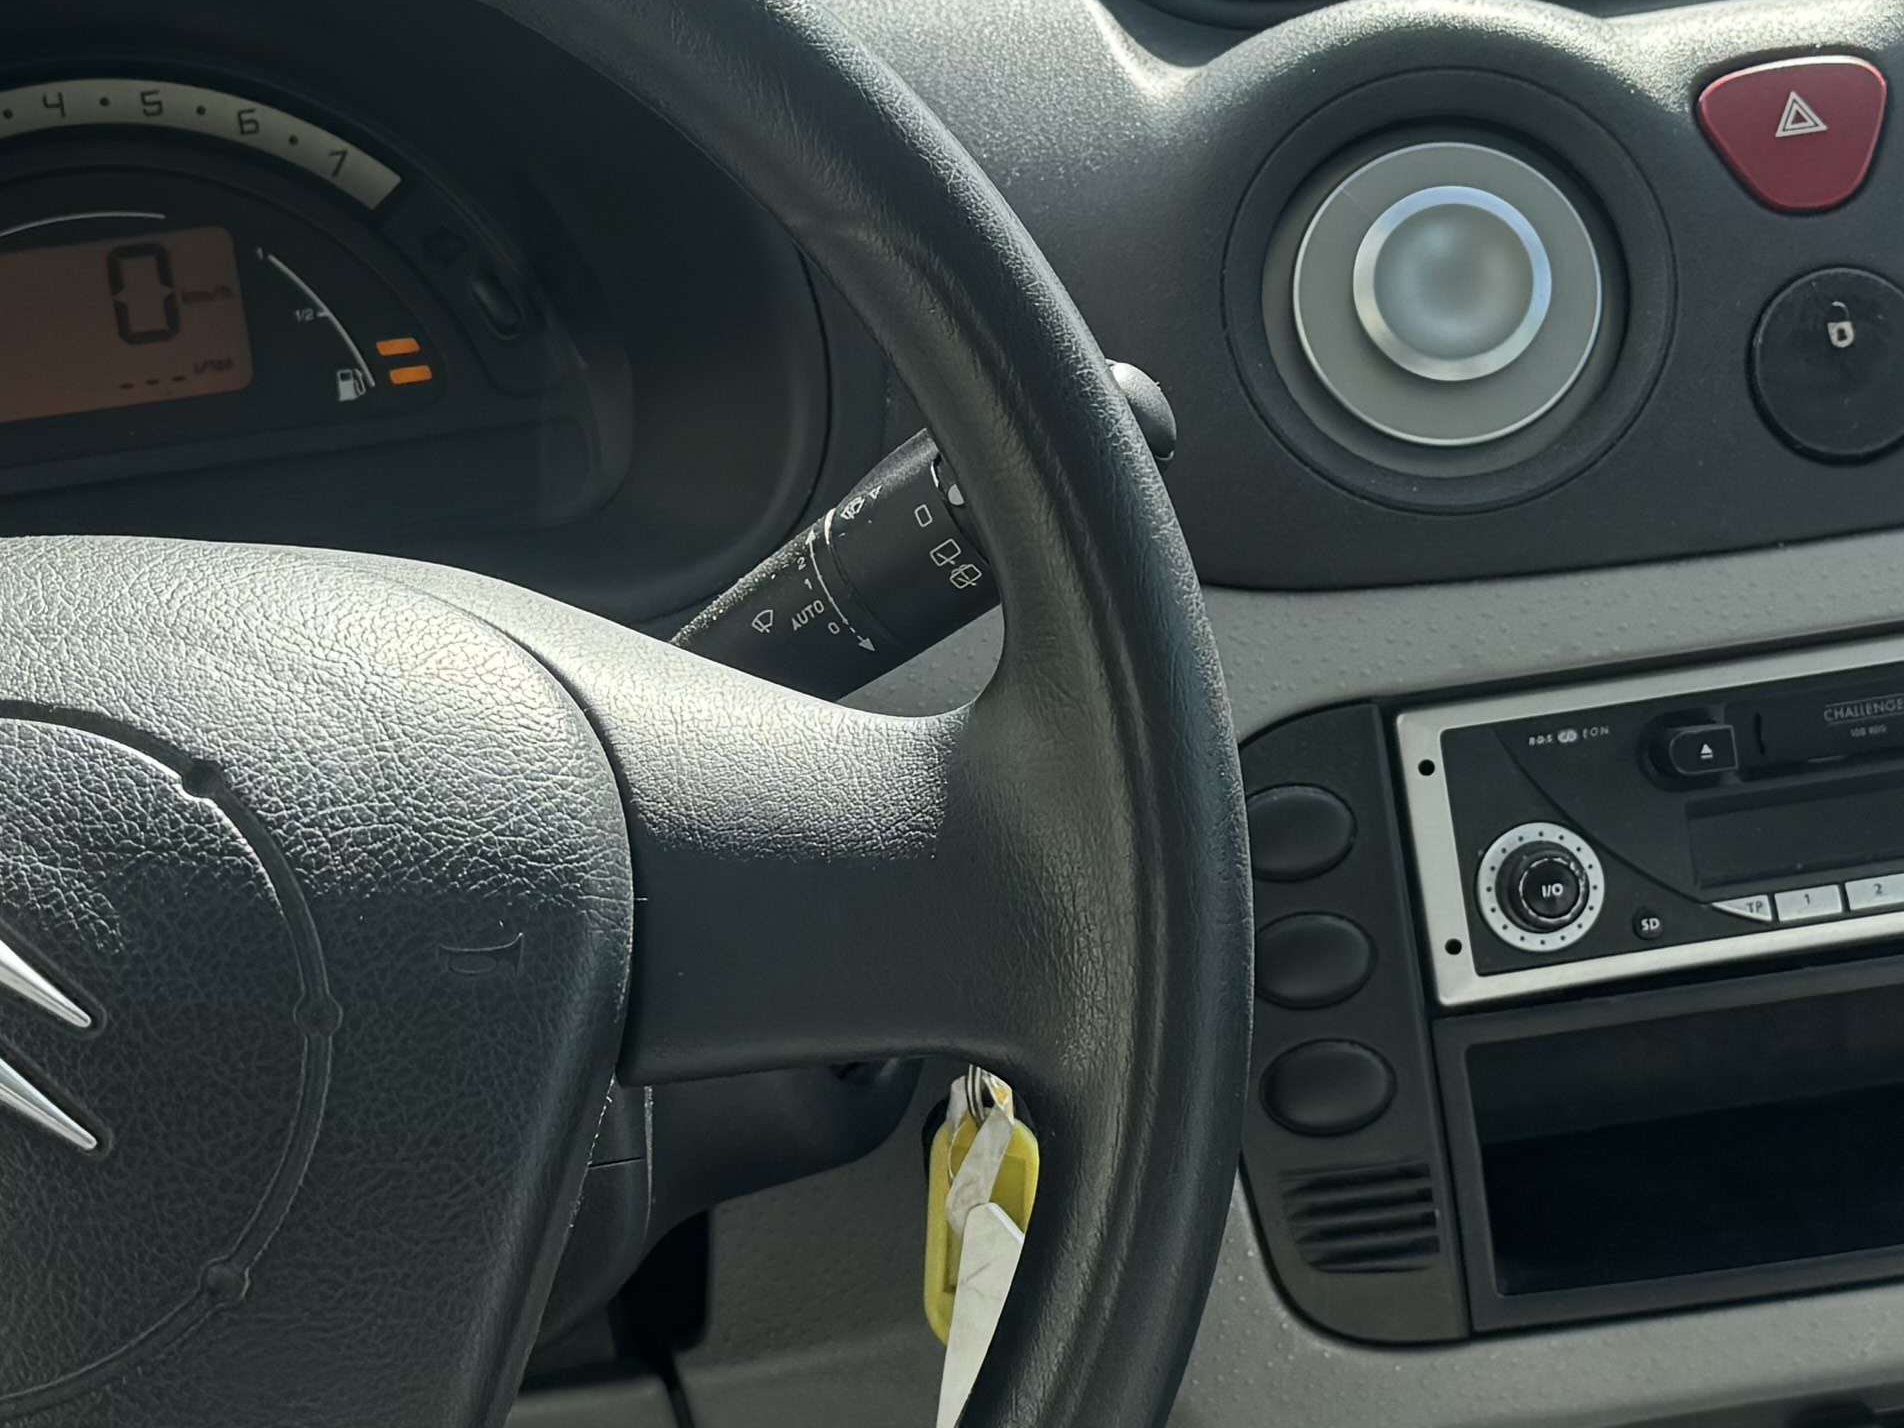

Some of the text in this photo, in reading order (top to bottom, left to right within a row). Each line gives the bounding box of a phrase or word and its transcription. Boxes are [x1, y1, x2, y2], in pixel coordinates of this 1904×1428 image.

[42, 91, 66, 118] 4
[141, 89, 163, 117] 5
[237, 107, 260, 135] 6
[329, 149, 348, 178] 7
[106, 243, 180, 345] 0
[792, 600, 825, 632] AUTO
[1823, 697, 1904, 722] CHALLENGE
[1803, 893, 1811, 905] 1
[1873, 883, 1883, 895] 2
[1746, 901, 1764, 914] TP
[1641, 917, 1661, 932] SD
